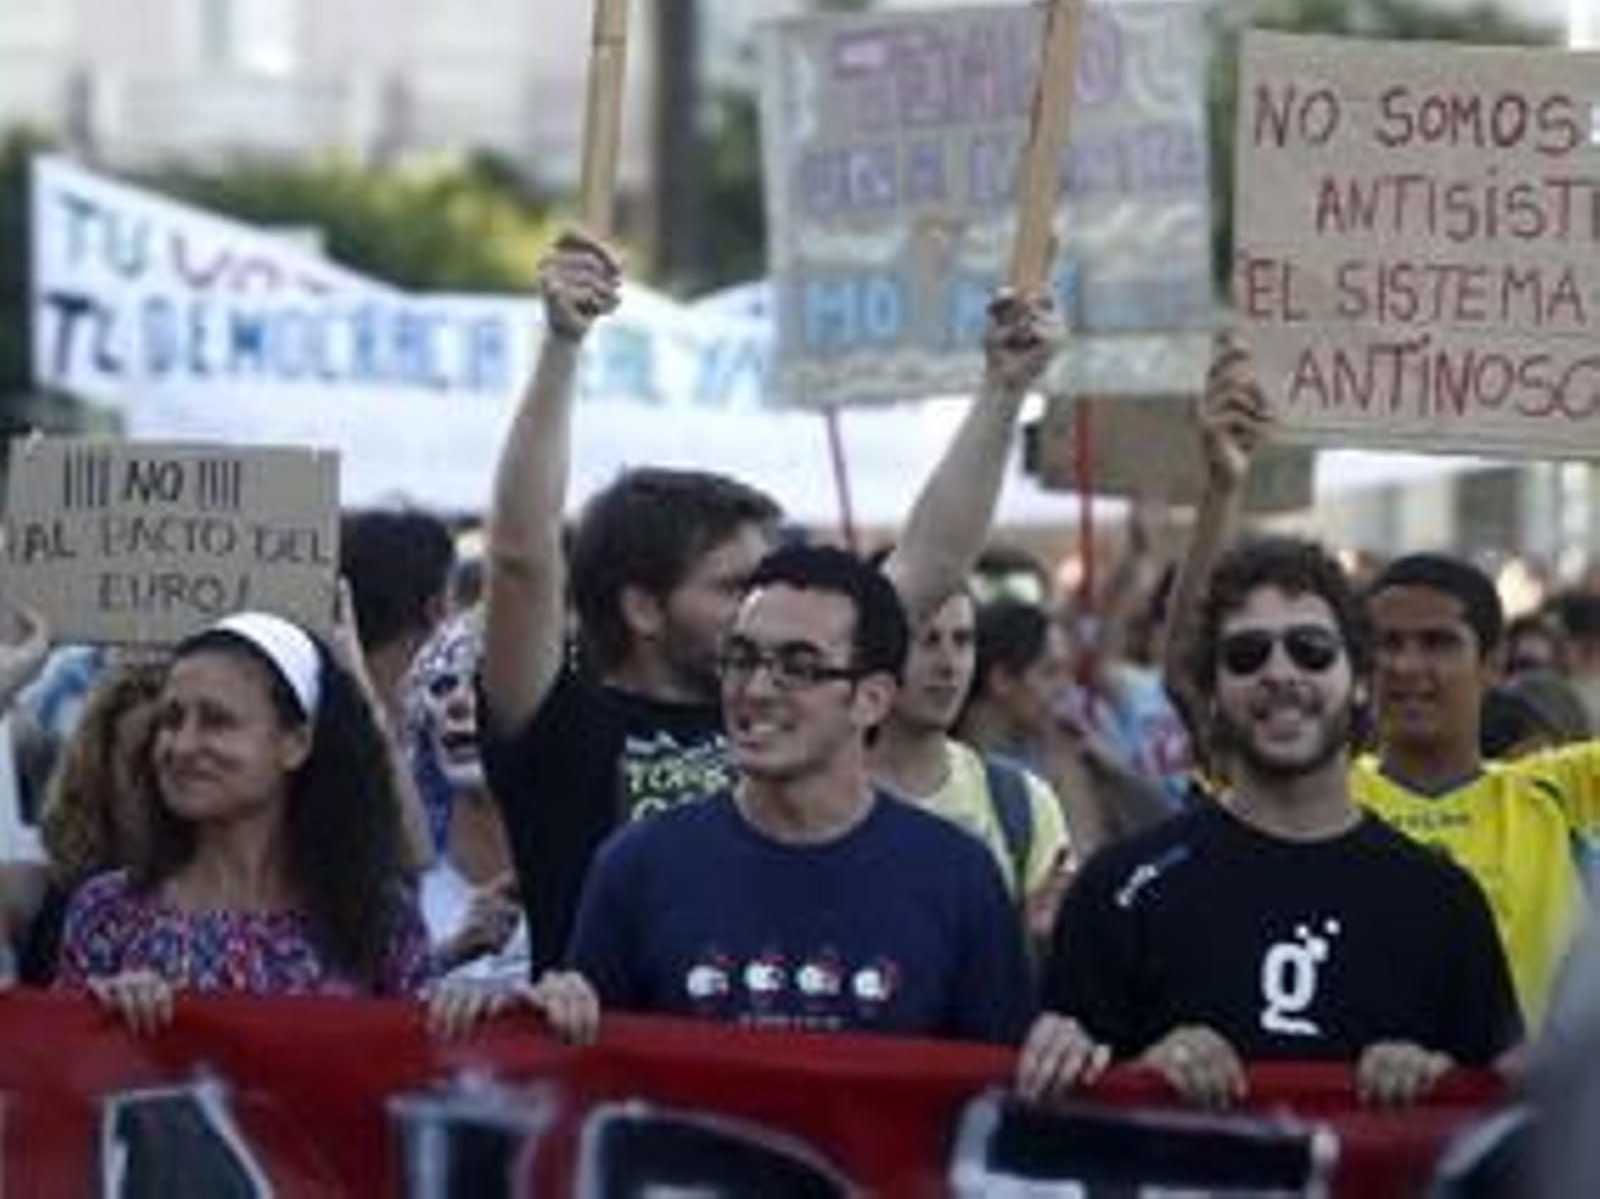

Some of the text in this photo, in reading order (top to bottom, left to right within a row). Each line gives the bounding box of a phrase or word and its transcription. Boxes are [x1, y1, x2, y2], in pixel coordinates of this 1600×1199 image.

[1254, 82, 1582, 156] NO SOMOS
[1244, 257, 1590, 328] EL SISTEMA
[124, 458, 185, 504] NO
[102, 515, 237, 558] PACTO
